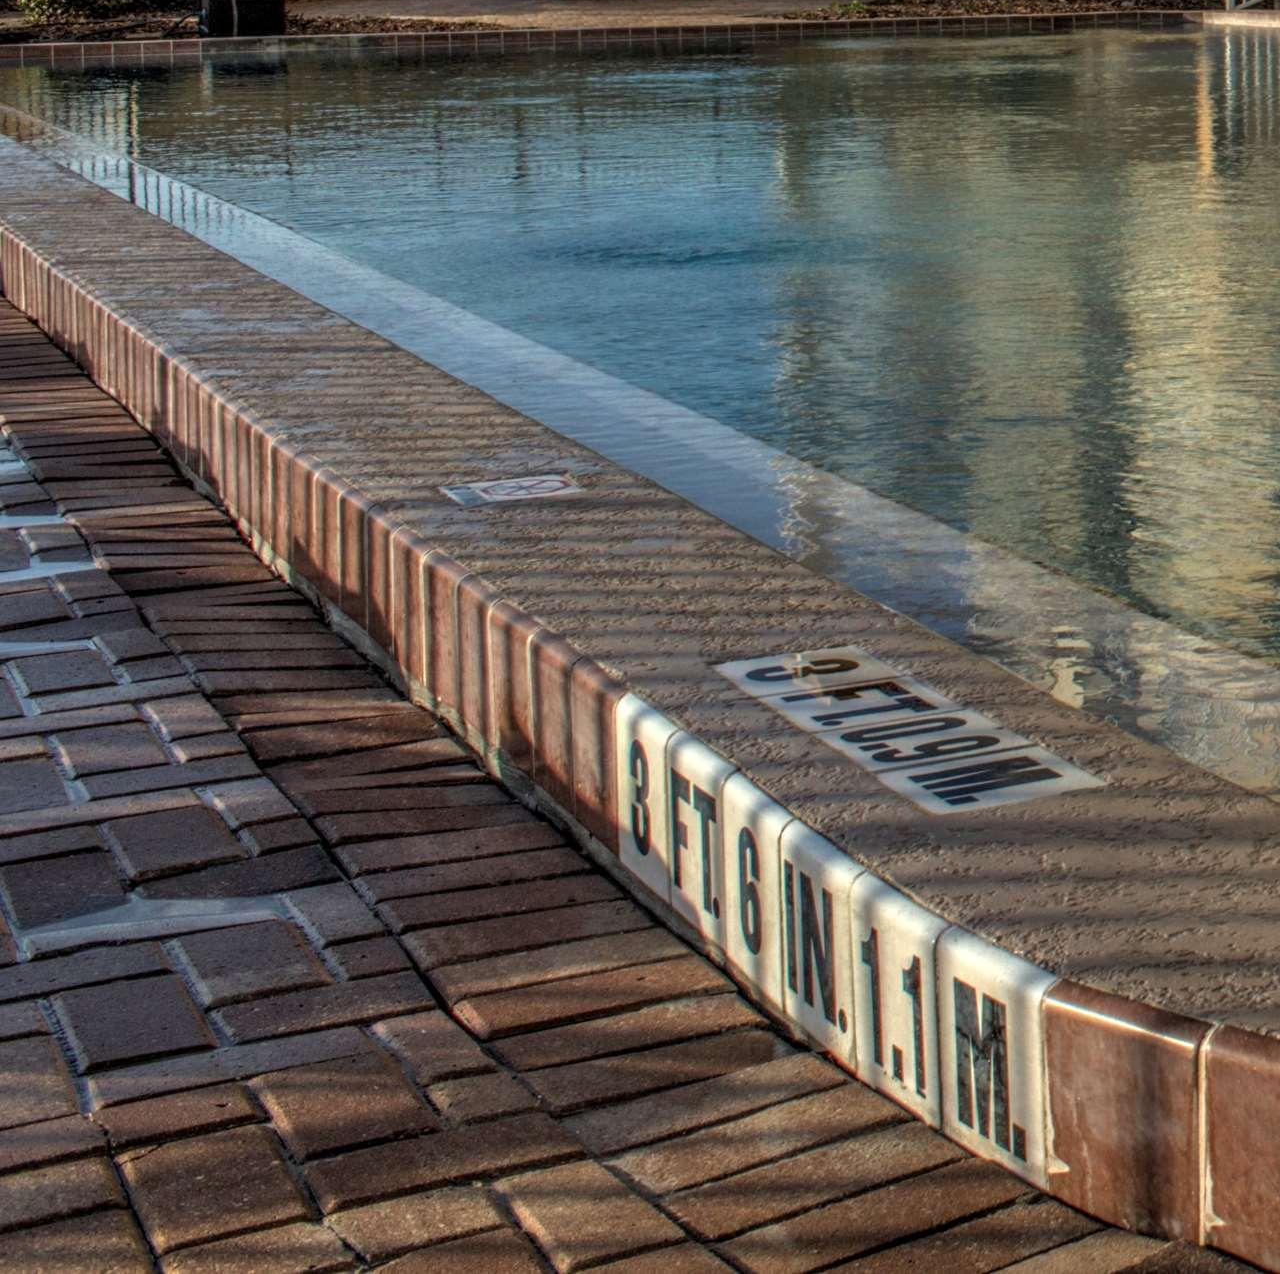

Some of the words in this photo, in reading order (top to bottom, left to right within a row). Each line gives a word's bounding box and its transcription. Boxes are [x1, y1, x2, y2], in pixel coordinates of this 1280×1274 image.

[745, 658, 861, 683] 3
[781, 681, 939, 727] FT.
[840, 716, 1001, 764] 0.9
[907, 756, 1063, 806] M.
[630, 739, 650, 856] 3
[671, 766, 721, 919] FT.
[738, 826, 762, 956] 6
[784, 859, 847, 1034] IN.
[860, 927, 926, 1098] 1.1
[953, 977, 1027, 1162] M.
